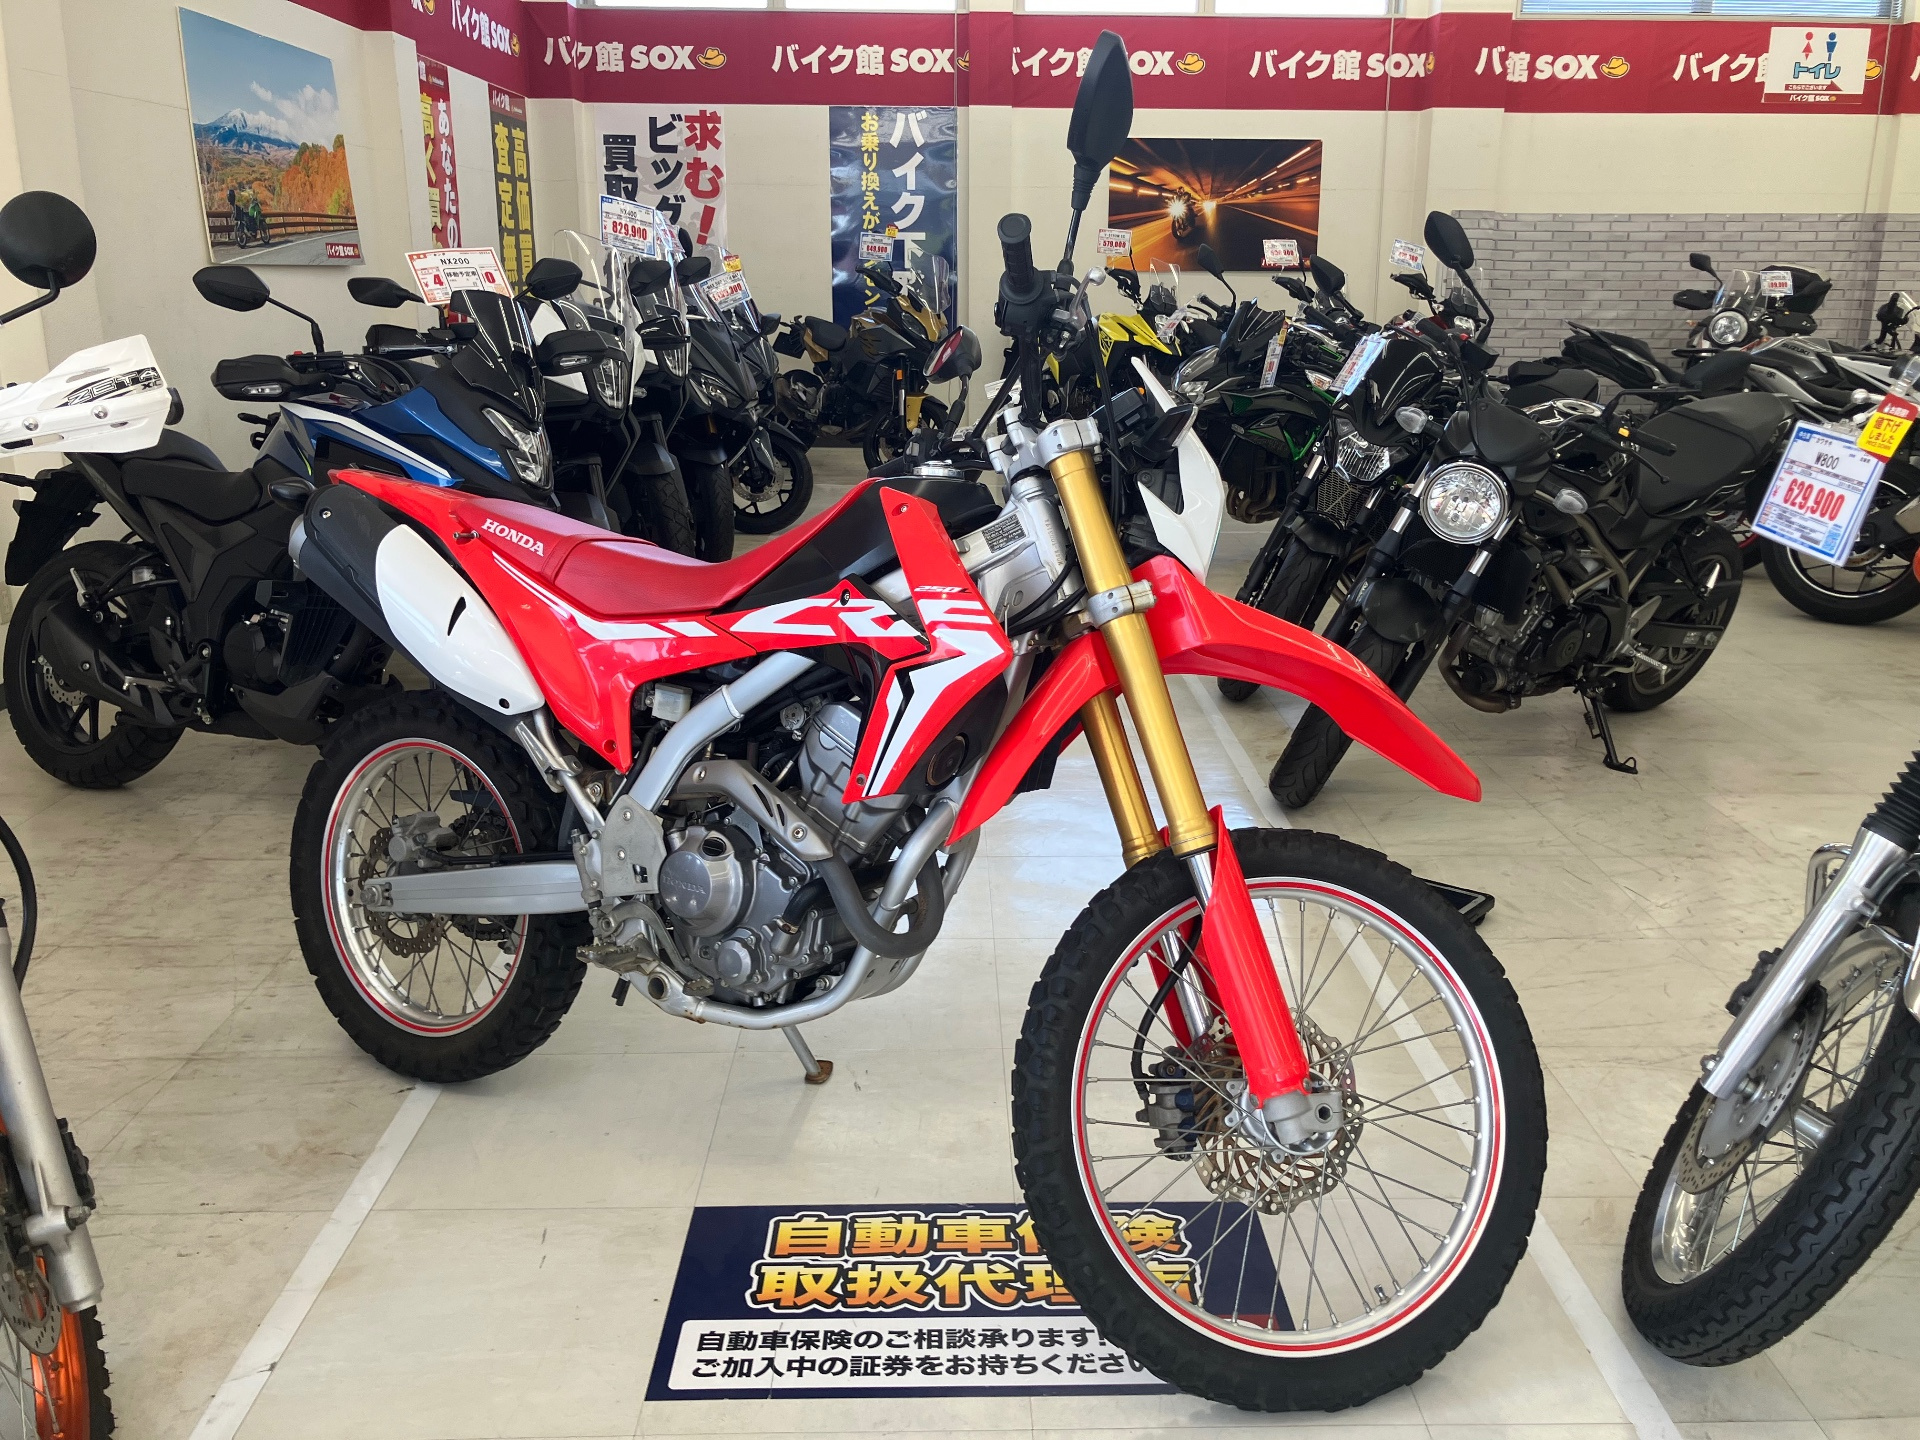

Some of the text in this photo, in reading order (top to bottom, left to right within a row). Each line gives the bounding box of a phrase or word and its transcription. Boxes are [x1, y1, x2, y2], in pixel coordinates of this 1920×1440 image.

[1793, 62, 1841, 79] トイレ
[684, 110, 724, 245] 求む!
[1782, 343, 1811, 356] SUZUKI
[67, 368, 159, 406] ZETA
[1873, 416, 1903, 433] 値下げ
[1869, 429, 1895, 444] しました
[1814, 452, 1840, 470] W800
[1783, 478, 1845, 522] 629,900
[481, 518, 544, 557] HONDA
